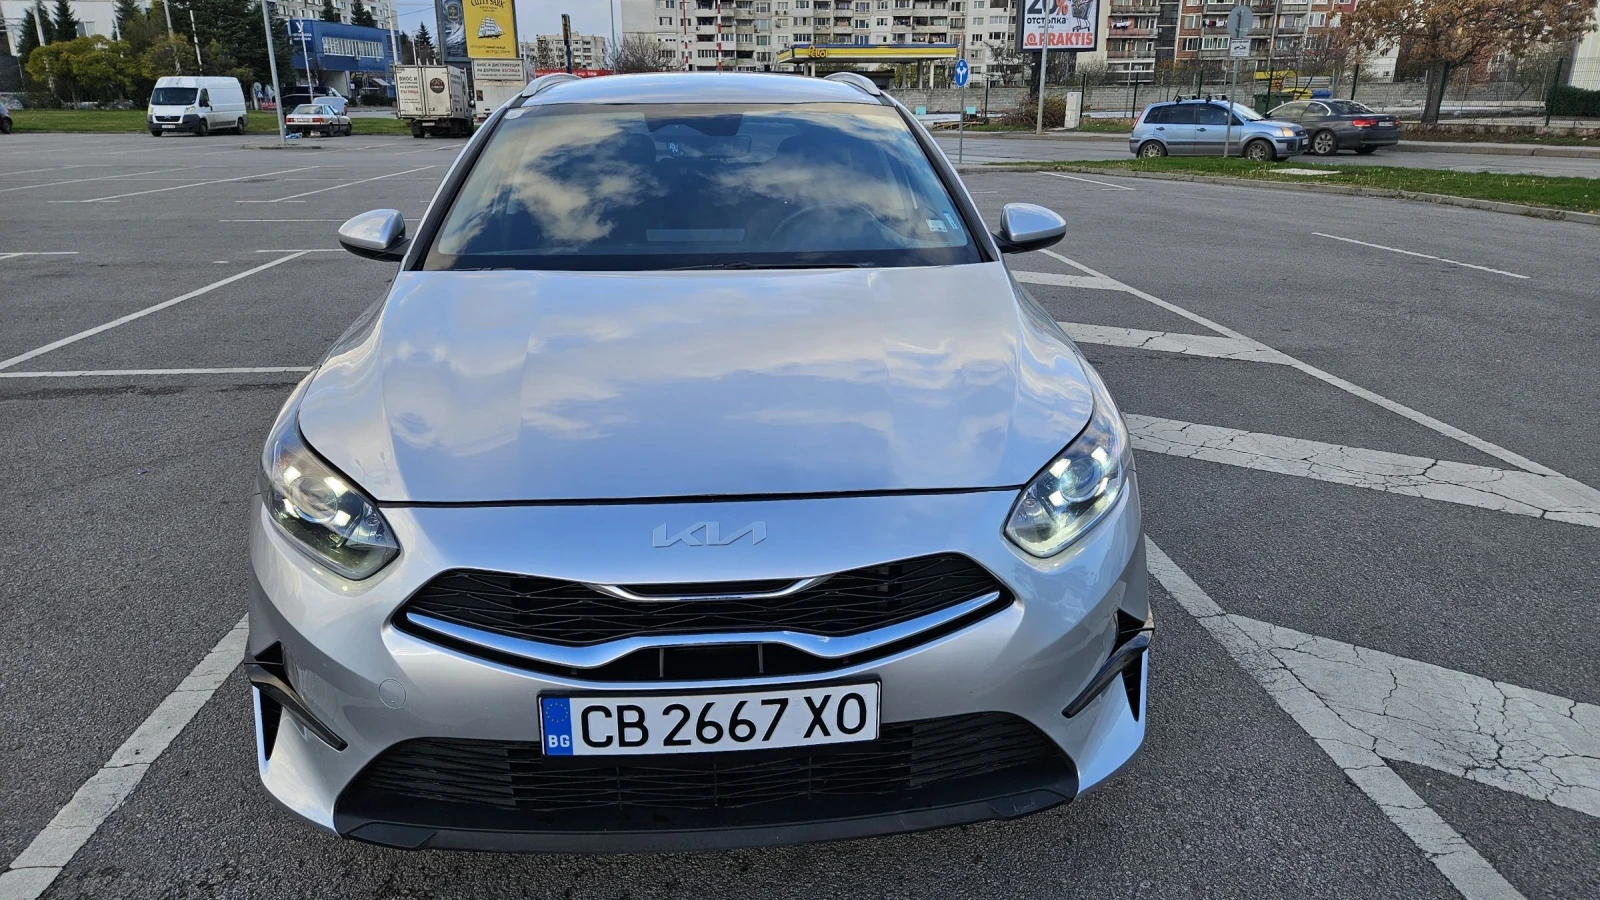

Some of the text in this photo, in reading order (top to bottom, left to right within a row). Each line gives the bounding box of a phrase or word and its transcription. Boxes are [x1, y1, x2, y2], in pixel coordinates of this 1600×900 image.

[1039, 33, 1093, 46] PRAKTIS
[652, 521, 767, 548] KIA
[580, 704, 649, 748] CB
[661, 697, 789, 747] 2667
[548, 734, 570, 748] BG
